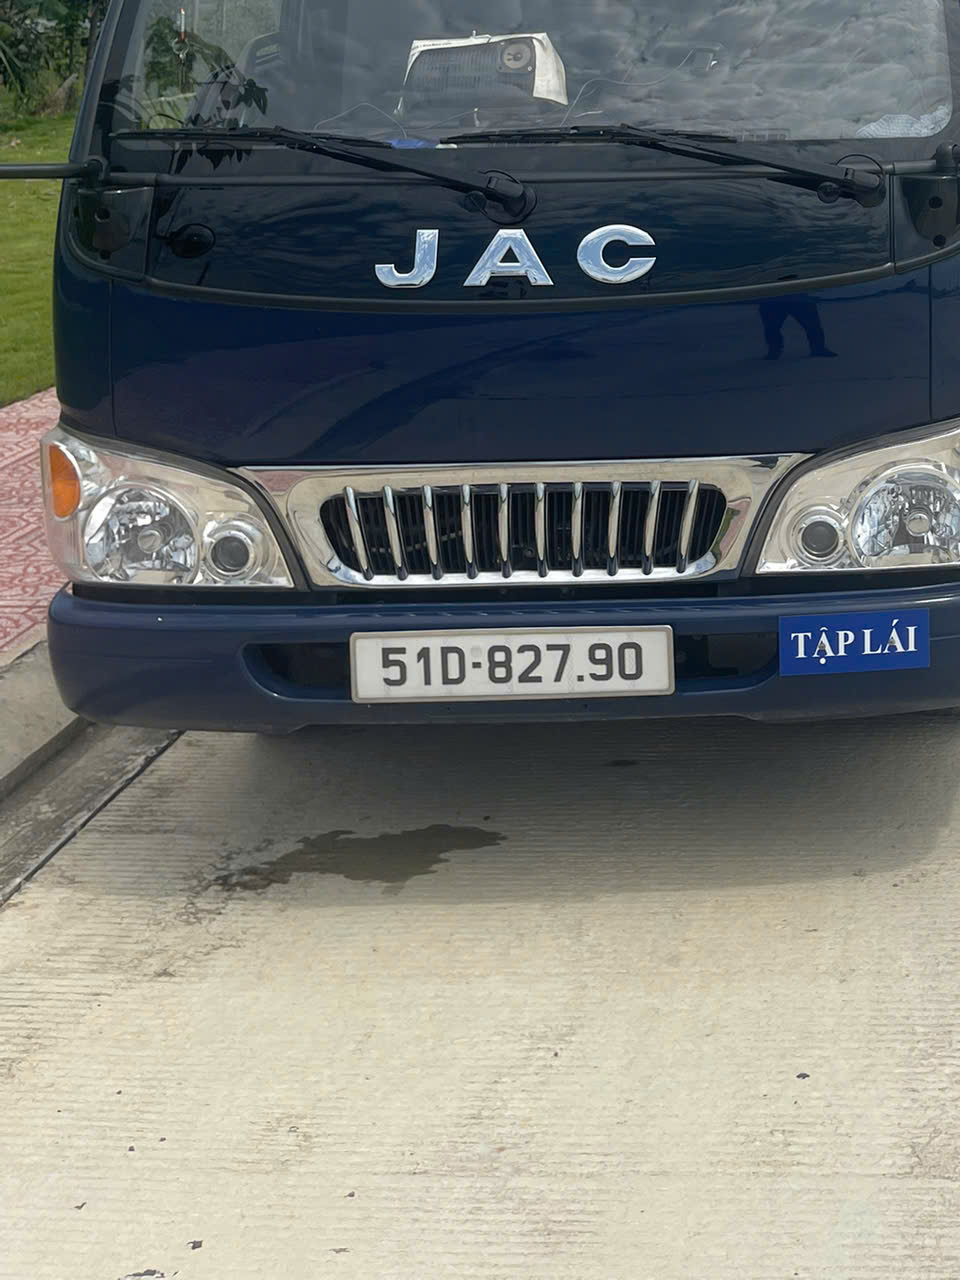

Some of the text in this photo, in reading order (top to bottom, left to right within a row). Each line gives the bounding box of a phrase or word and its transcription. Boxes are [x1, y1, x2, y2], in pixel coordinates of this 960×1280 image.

[374, 223, 657, 289] JAC
[380, 641, 644, 687] 51D-827.90
[790, 618, 919, 665] TẬP LÁI
